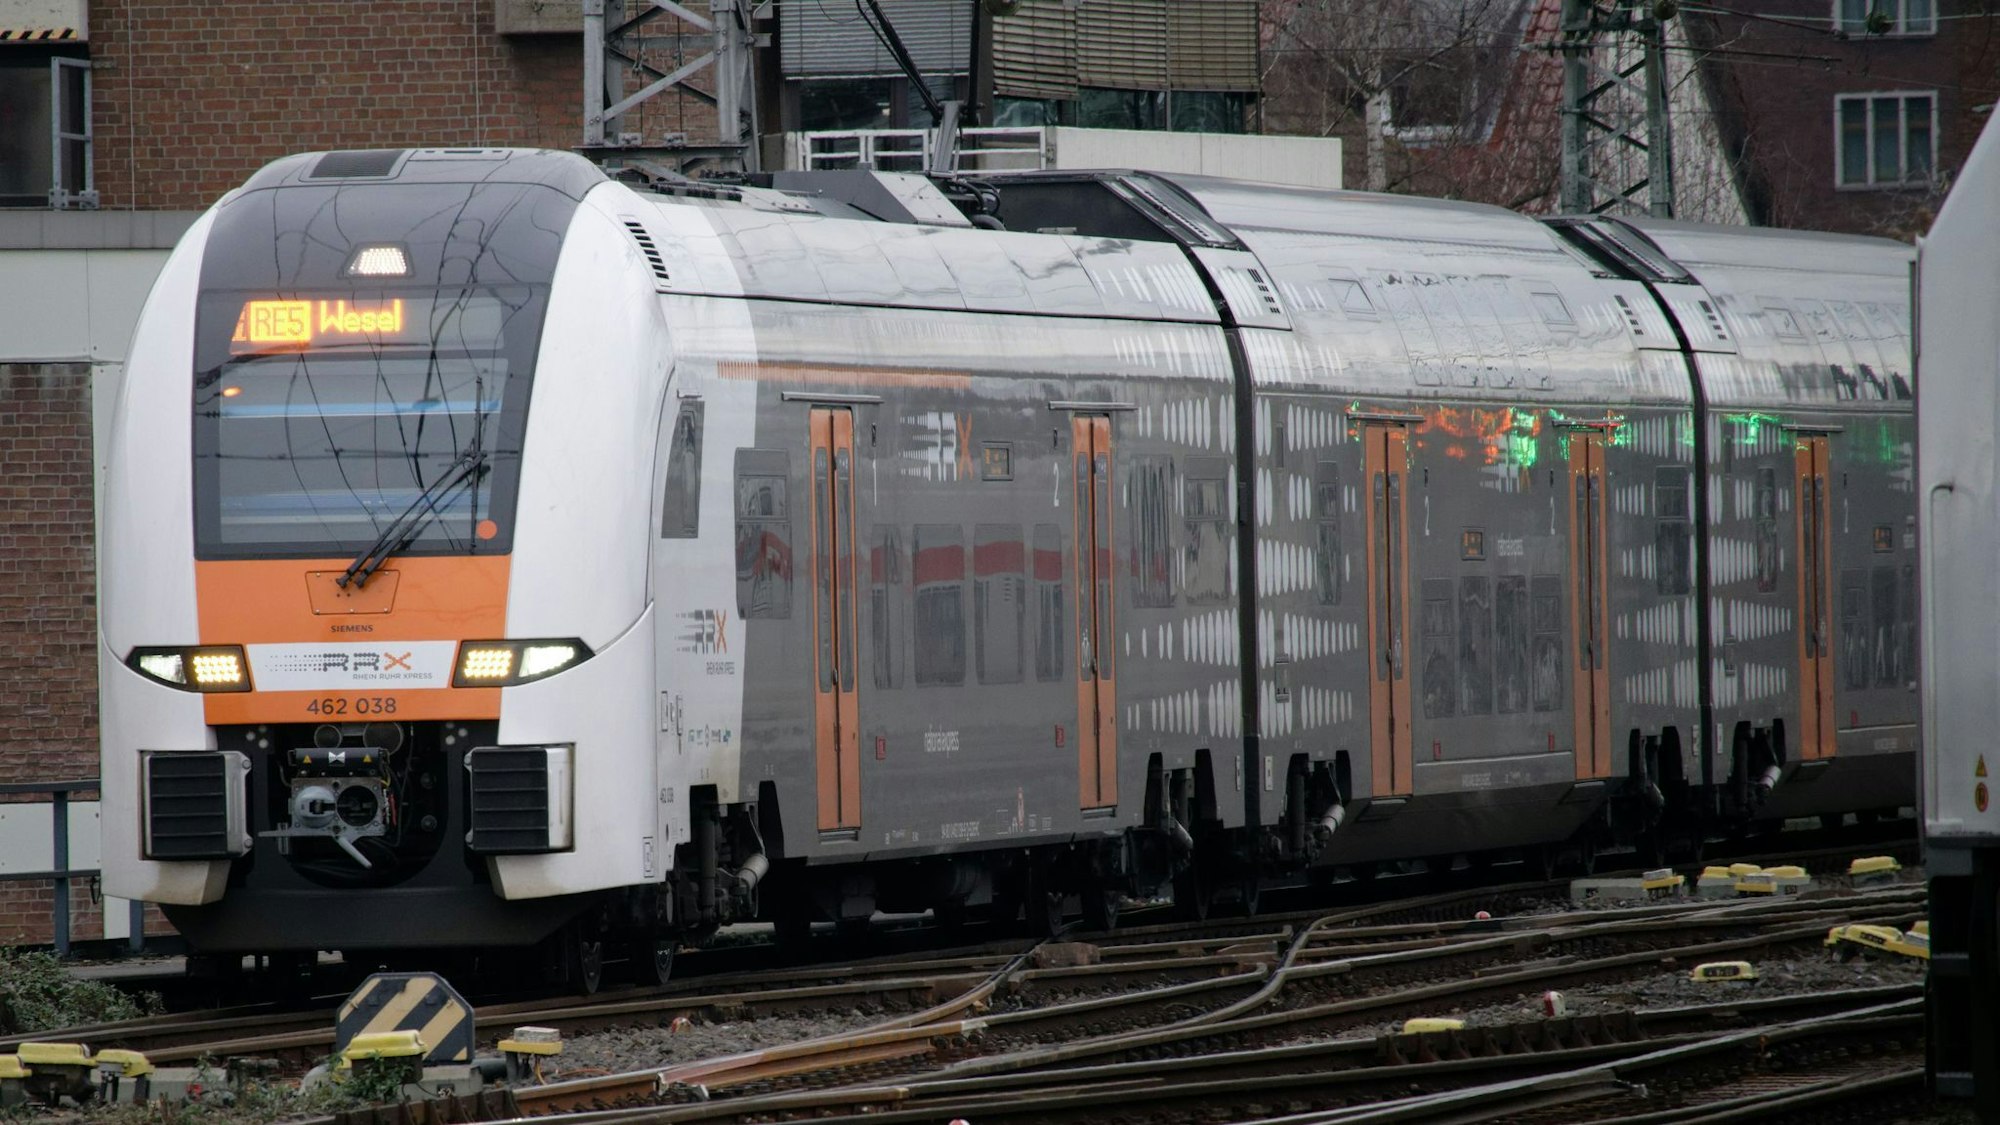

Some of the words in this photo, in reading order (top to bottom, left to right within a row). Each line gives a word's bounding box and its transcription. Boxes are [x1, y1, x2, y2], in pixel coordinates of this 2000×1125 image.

[254, 306, 305, 337] RE5
[319, 298, 402, 334] Wesel
[1053, 462, 1060, 508] 2
[330, 624, 374, 633] SIEMENS
[322, 652, 412, 672] RRX
[306, 698, 348, 715] 462
[355, 697, 397, 714] 038
